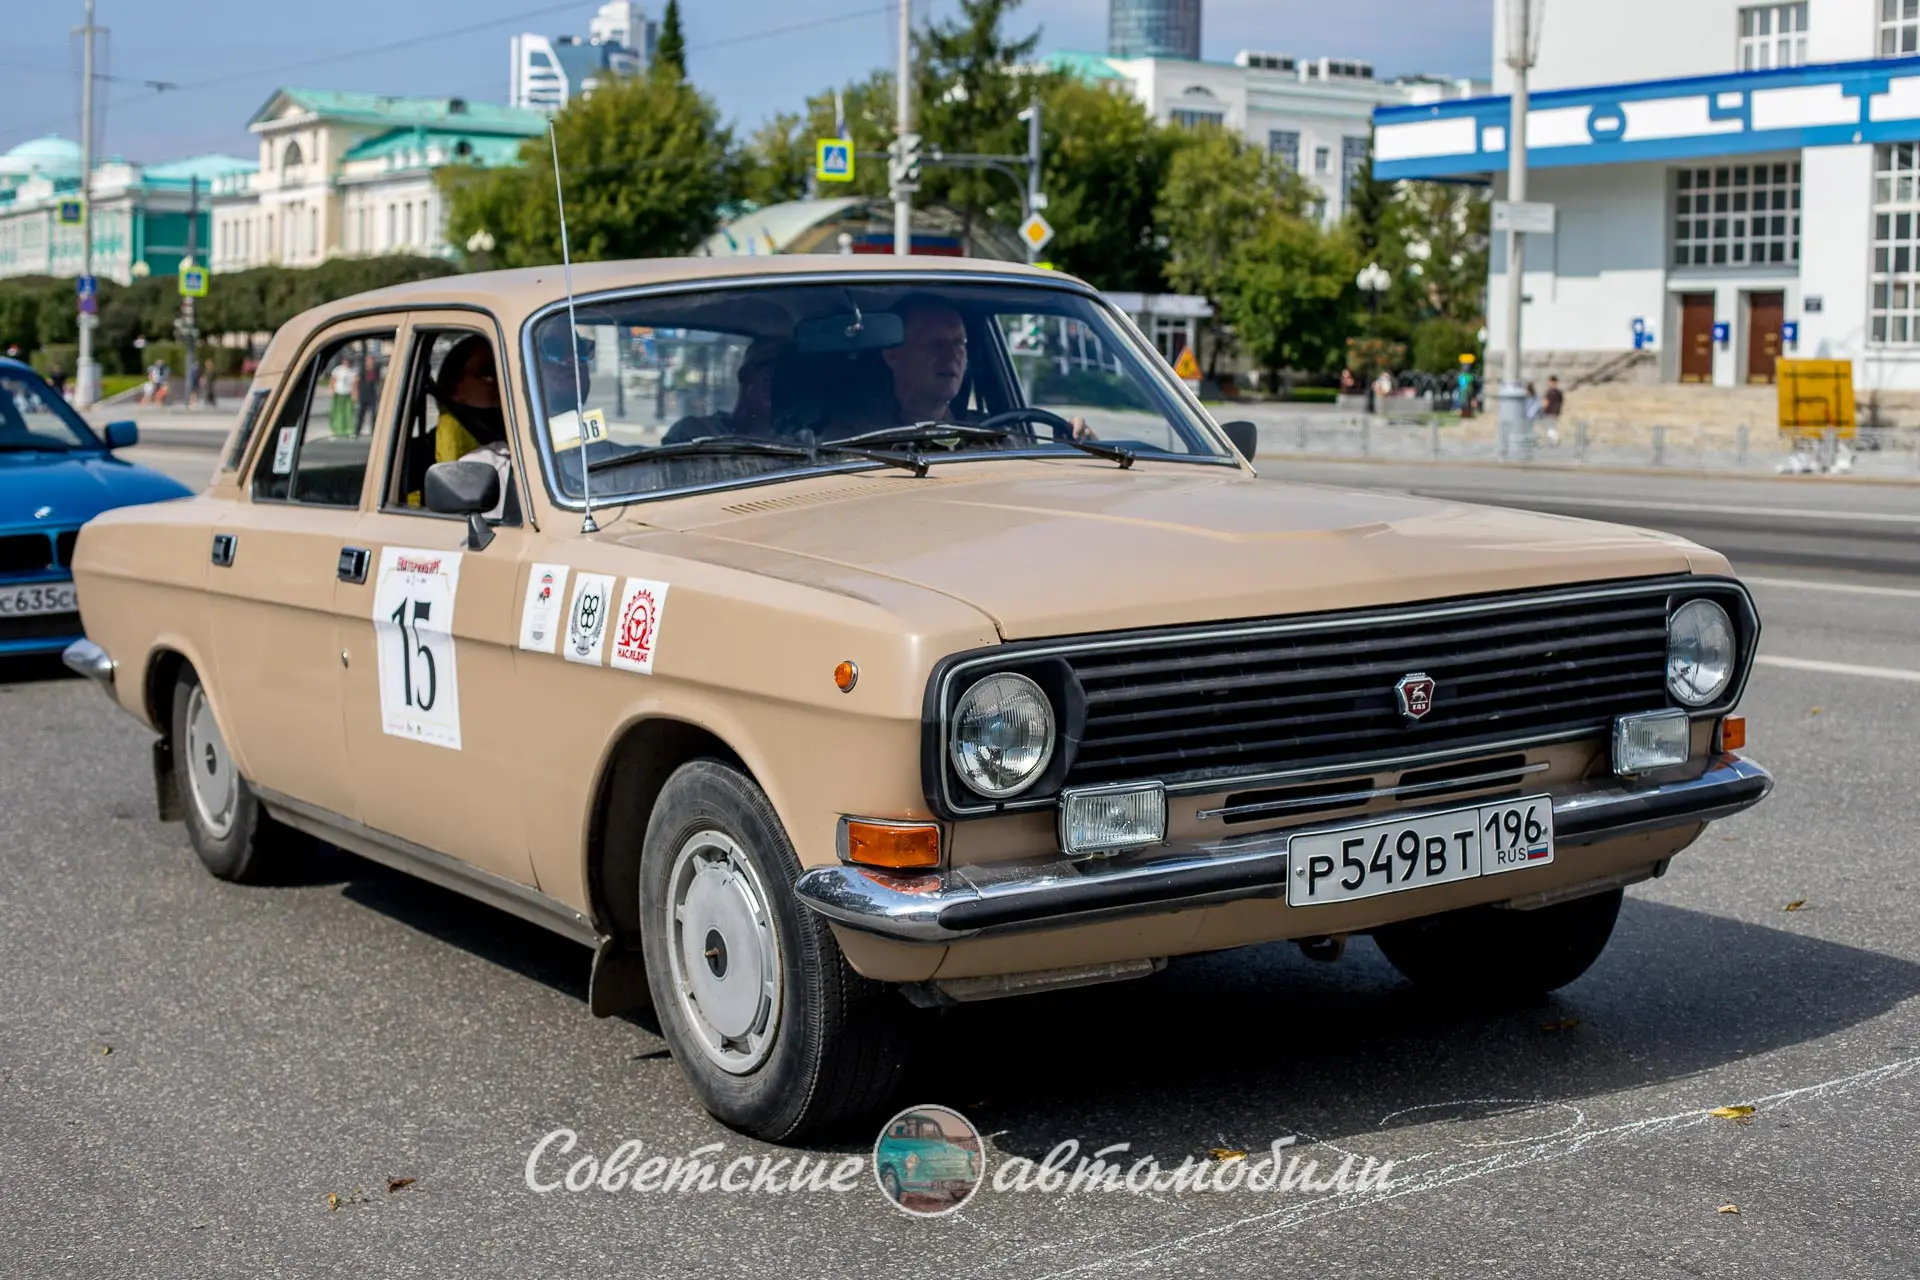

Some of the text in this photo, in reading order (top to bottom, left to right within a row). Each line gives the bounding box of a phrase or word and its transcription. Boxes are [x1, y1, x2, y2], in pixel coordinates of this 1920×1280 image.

[391, 597, 436, 711] 15
[617, 648, 648, 662] НАСЛЕДИЕ
[1308, 805, 1542, 896] Р549ВТ 196
[1498, 847, 1527, 865] RUS
